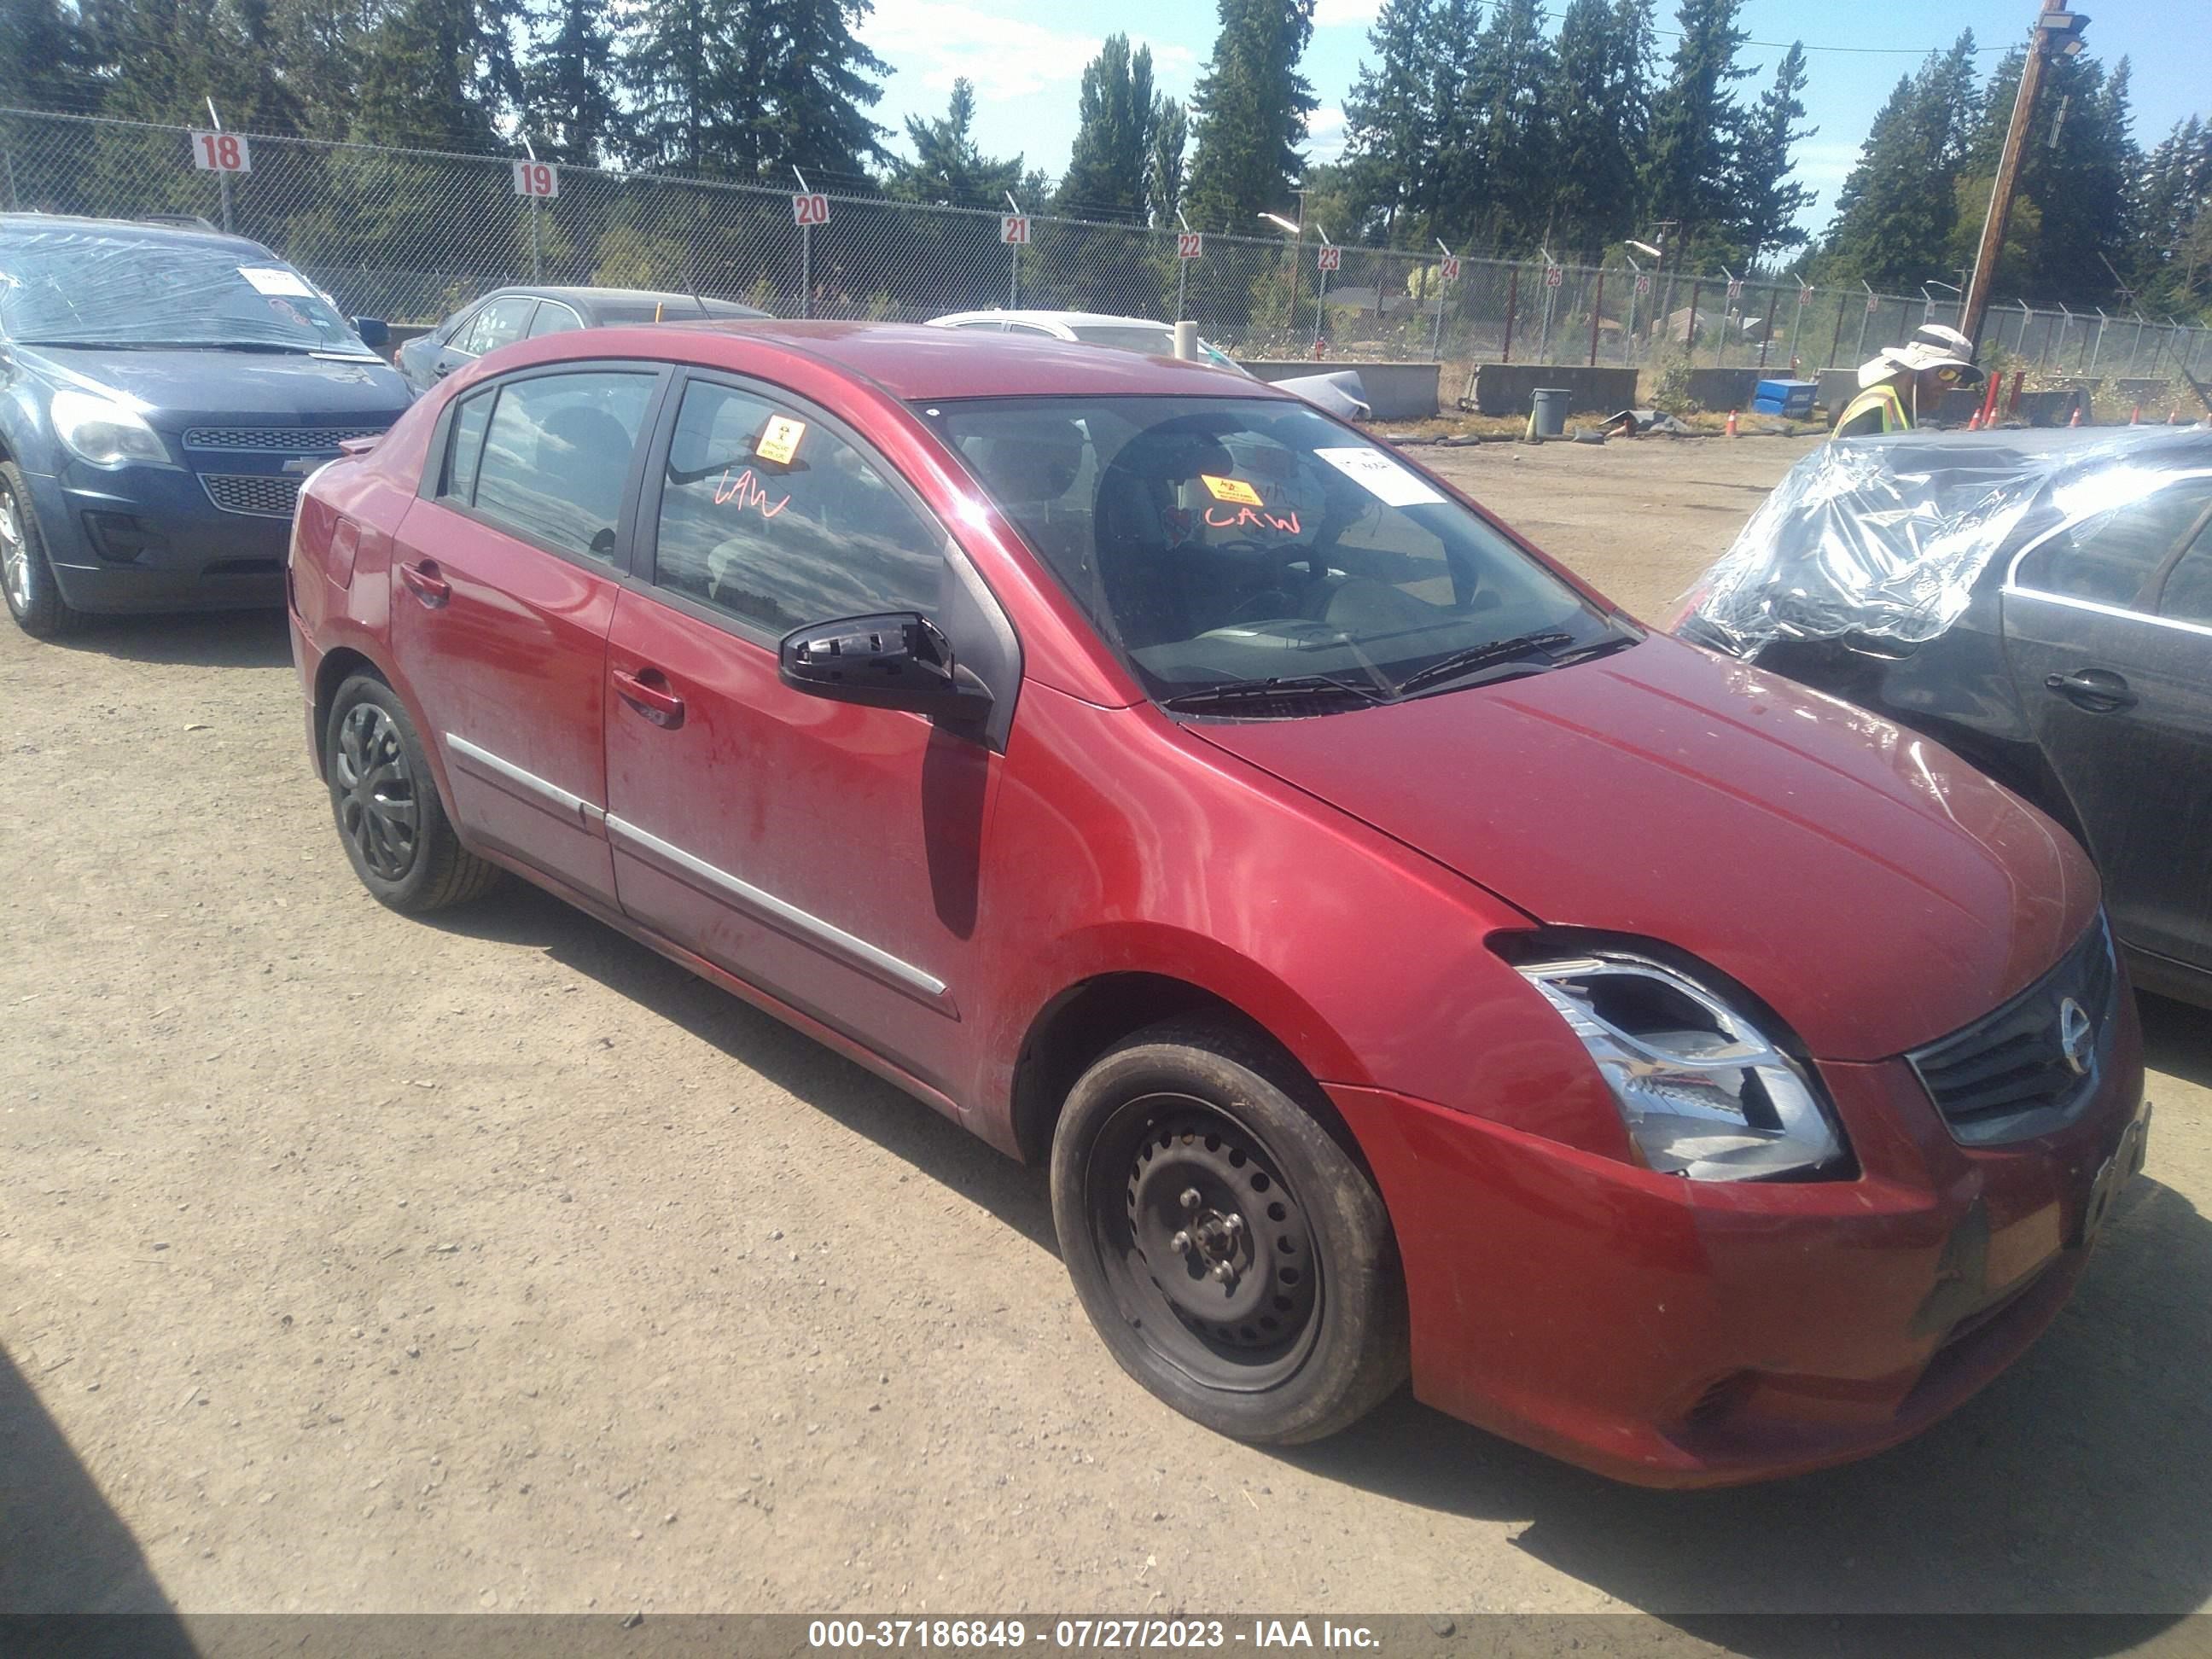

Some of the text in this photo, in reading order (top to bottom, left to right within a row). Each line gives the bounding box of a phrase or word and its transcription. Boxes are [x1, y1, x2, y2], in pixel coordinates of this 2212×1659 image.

[201, 135, 241, 170] 18
[521, 164, 551, 195] 19
[796, 195, 827, 223] 20
[1005, 218, 1026, 242] 21
[1179, 235, 1200, 258] 22
[1319, 248, 1339, 269] 23
[1441, 258, 1458, 279] 24
[1547, 267, 1561, 287] 25
[1635, 276, 1649, 294] 26
